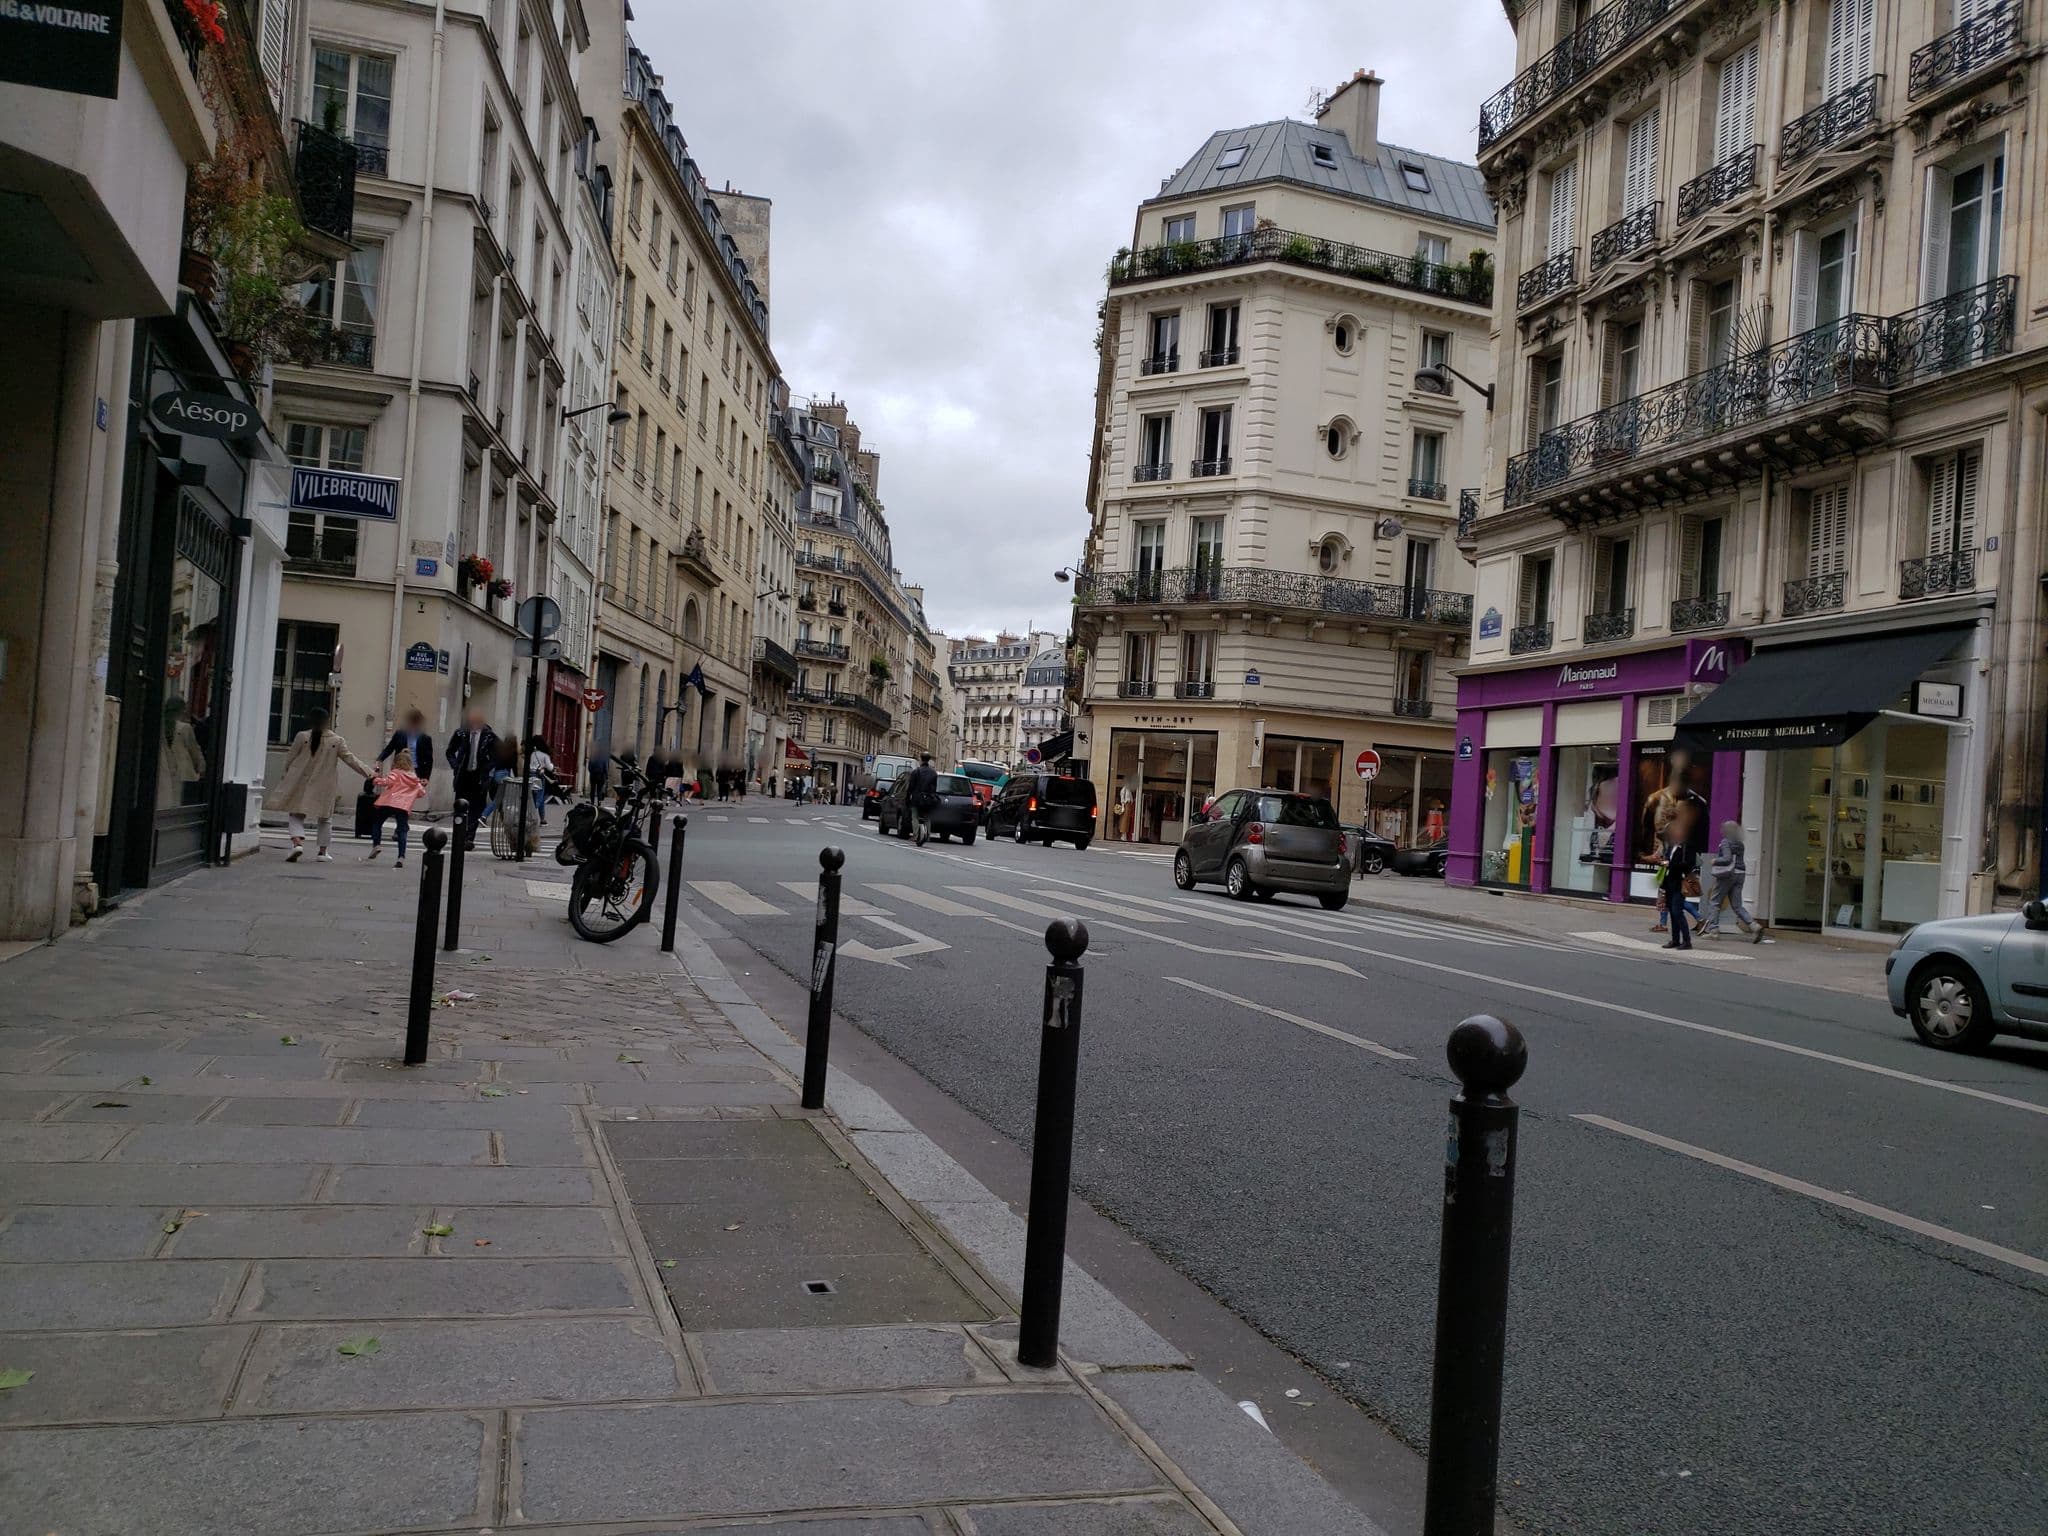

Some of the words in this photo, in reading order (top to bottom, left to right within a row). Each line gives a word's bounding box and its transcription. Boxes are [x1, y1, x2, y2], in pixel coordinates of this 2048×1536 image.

[20, 4, 33, 21] &
[35, 4, 110, 34] VOLTAIRE
[298, 473, 393, 514] VILEBREQUIN
[1988, 537, 1996, 551] 8
[1694, 645, 1724, 676] M
[1557, 663, 1617, 687] Marionnaud
[1579, 682, 1594, 690] PARIS
[1726, 728, 1771, 739] PÂTISSERIE
